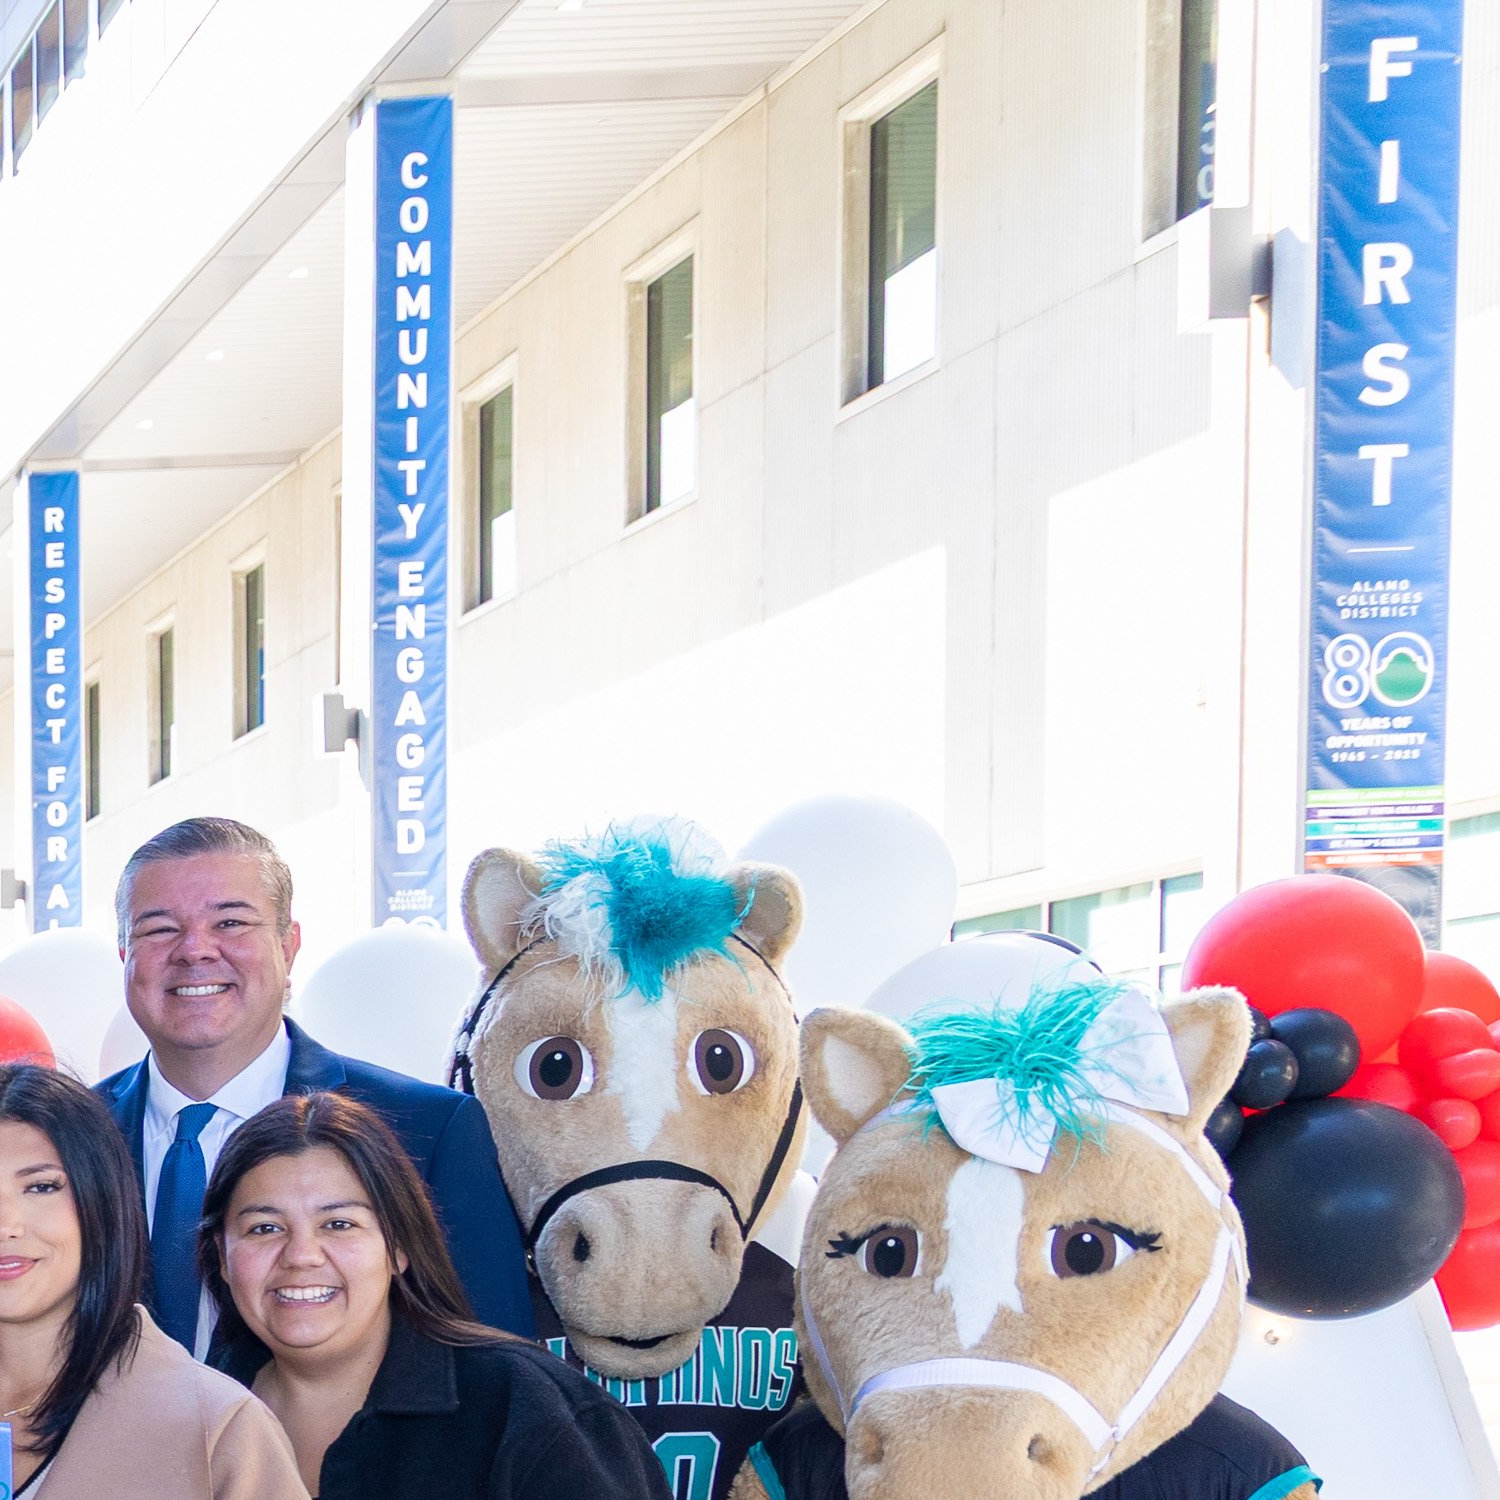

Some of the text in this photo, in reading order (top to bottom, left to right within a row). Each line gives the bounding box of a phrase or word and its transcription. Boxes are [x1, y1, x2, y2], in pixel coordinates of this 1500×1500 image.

[1357, 36, 1418, 507] FIRST
[394, 151, 432, 856] COMMUNITY ENGAGED
[44, 506, 66, 745] RESPECT
[1336, 592, 1424, 607] COLLEGES
[1340, 605, 1420, 620] DISTRICT
[1351, 578, 1410, 593] ALAMO
[1322, 631, 1435, 709] 80
[46, 766, 68, 863] FOR
